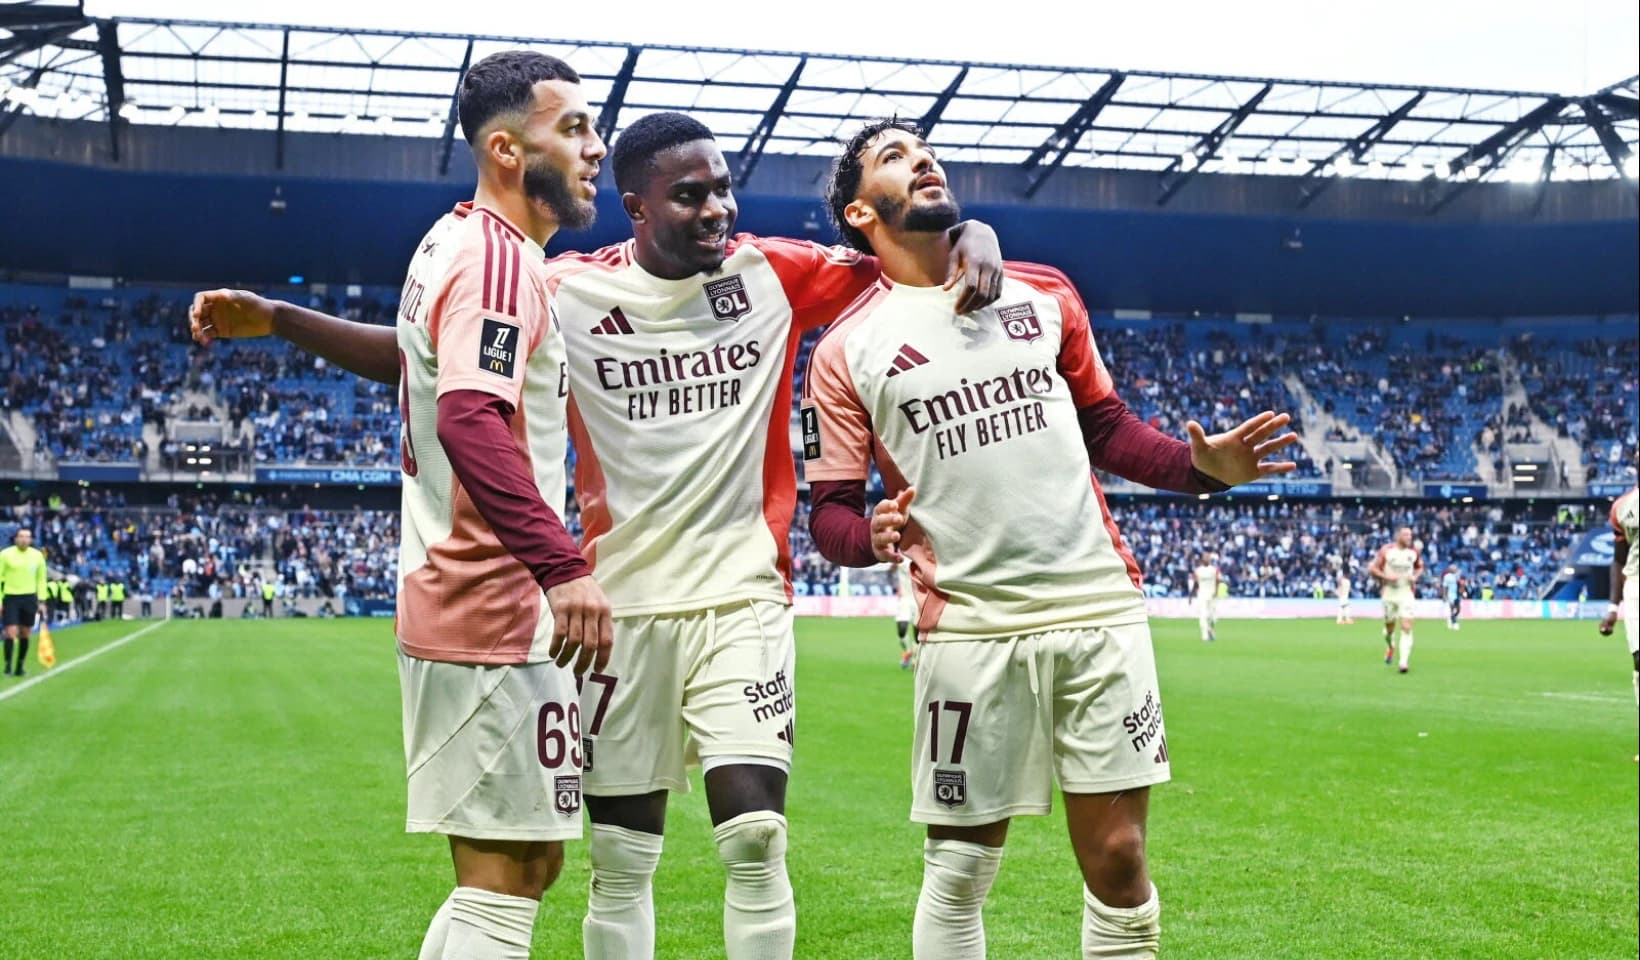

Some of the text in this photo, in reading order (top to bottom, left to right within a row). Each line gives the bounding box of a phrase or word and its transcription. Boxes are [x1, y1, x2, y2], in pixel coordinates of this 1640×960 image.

[715, 292, 748, 314] OL
[1007, 318, 1039, 336] OL
[483, 345, 508, 361] LIGUE
[594, 340, 761, 391] Emirates
[628, 378, 741, 421] FLY BETTER
[897, 365, 1053, 435] Emirates
[935, 401, 1048, 460] FLY BETTER
[743, 669, 788, 704] Staff
[928, 700, 973, 764] 17
[1122, 690, 1154, 735] Staff
[537, 701, 583, 769] 69
[558, 791, 579, 809] OL
